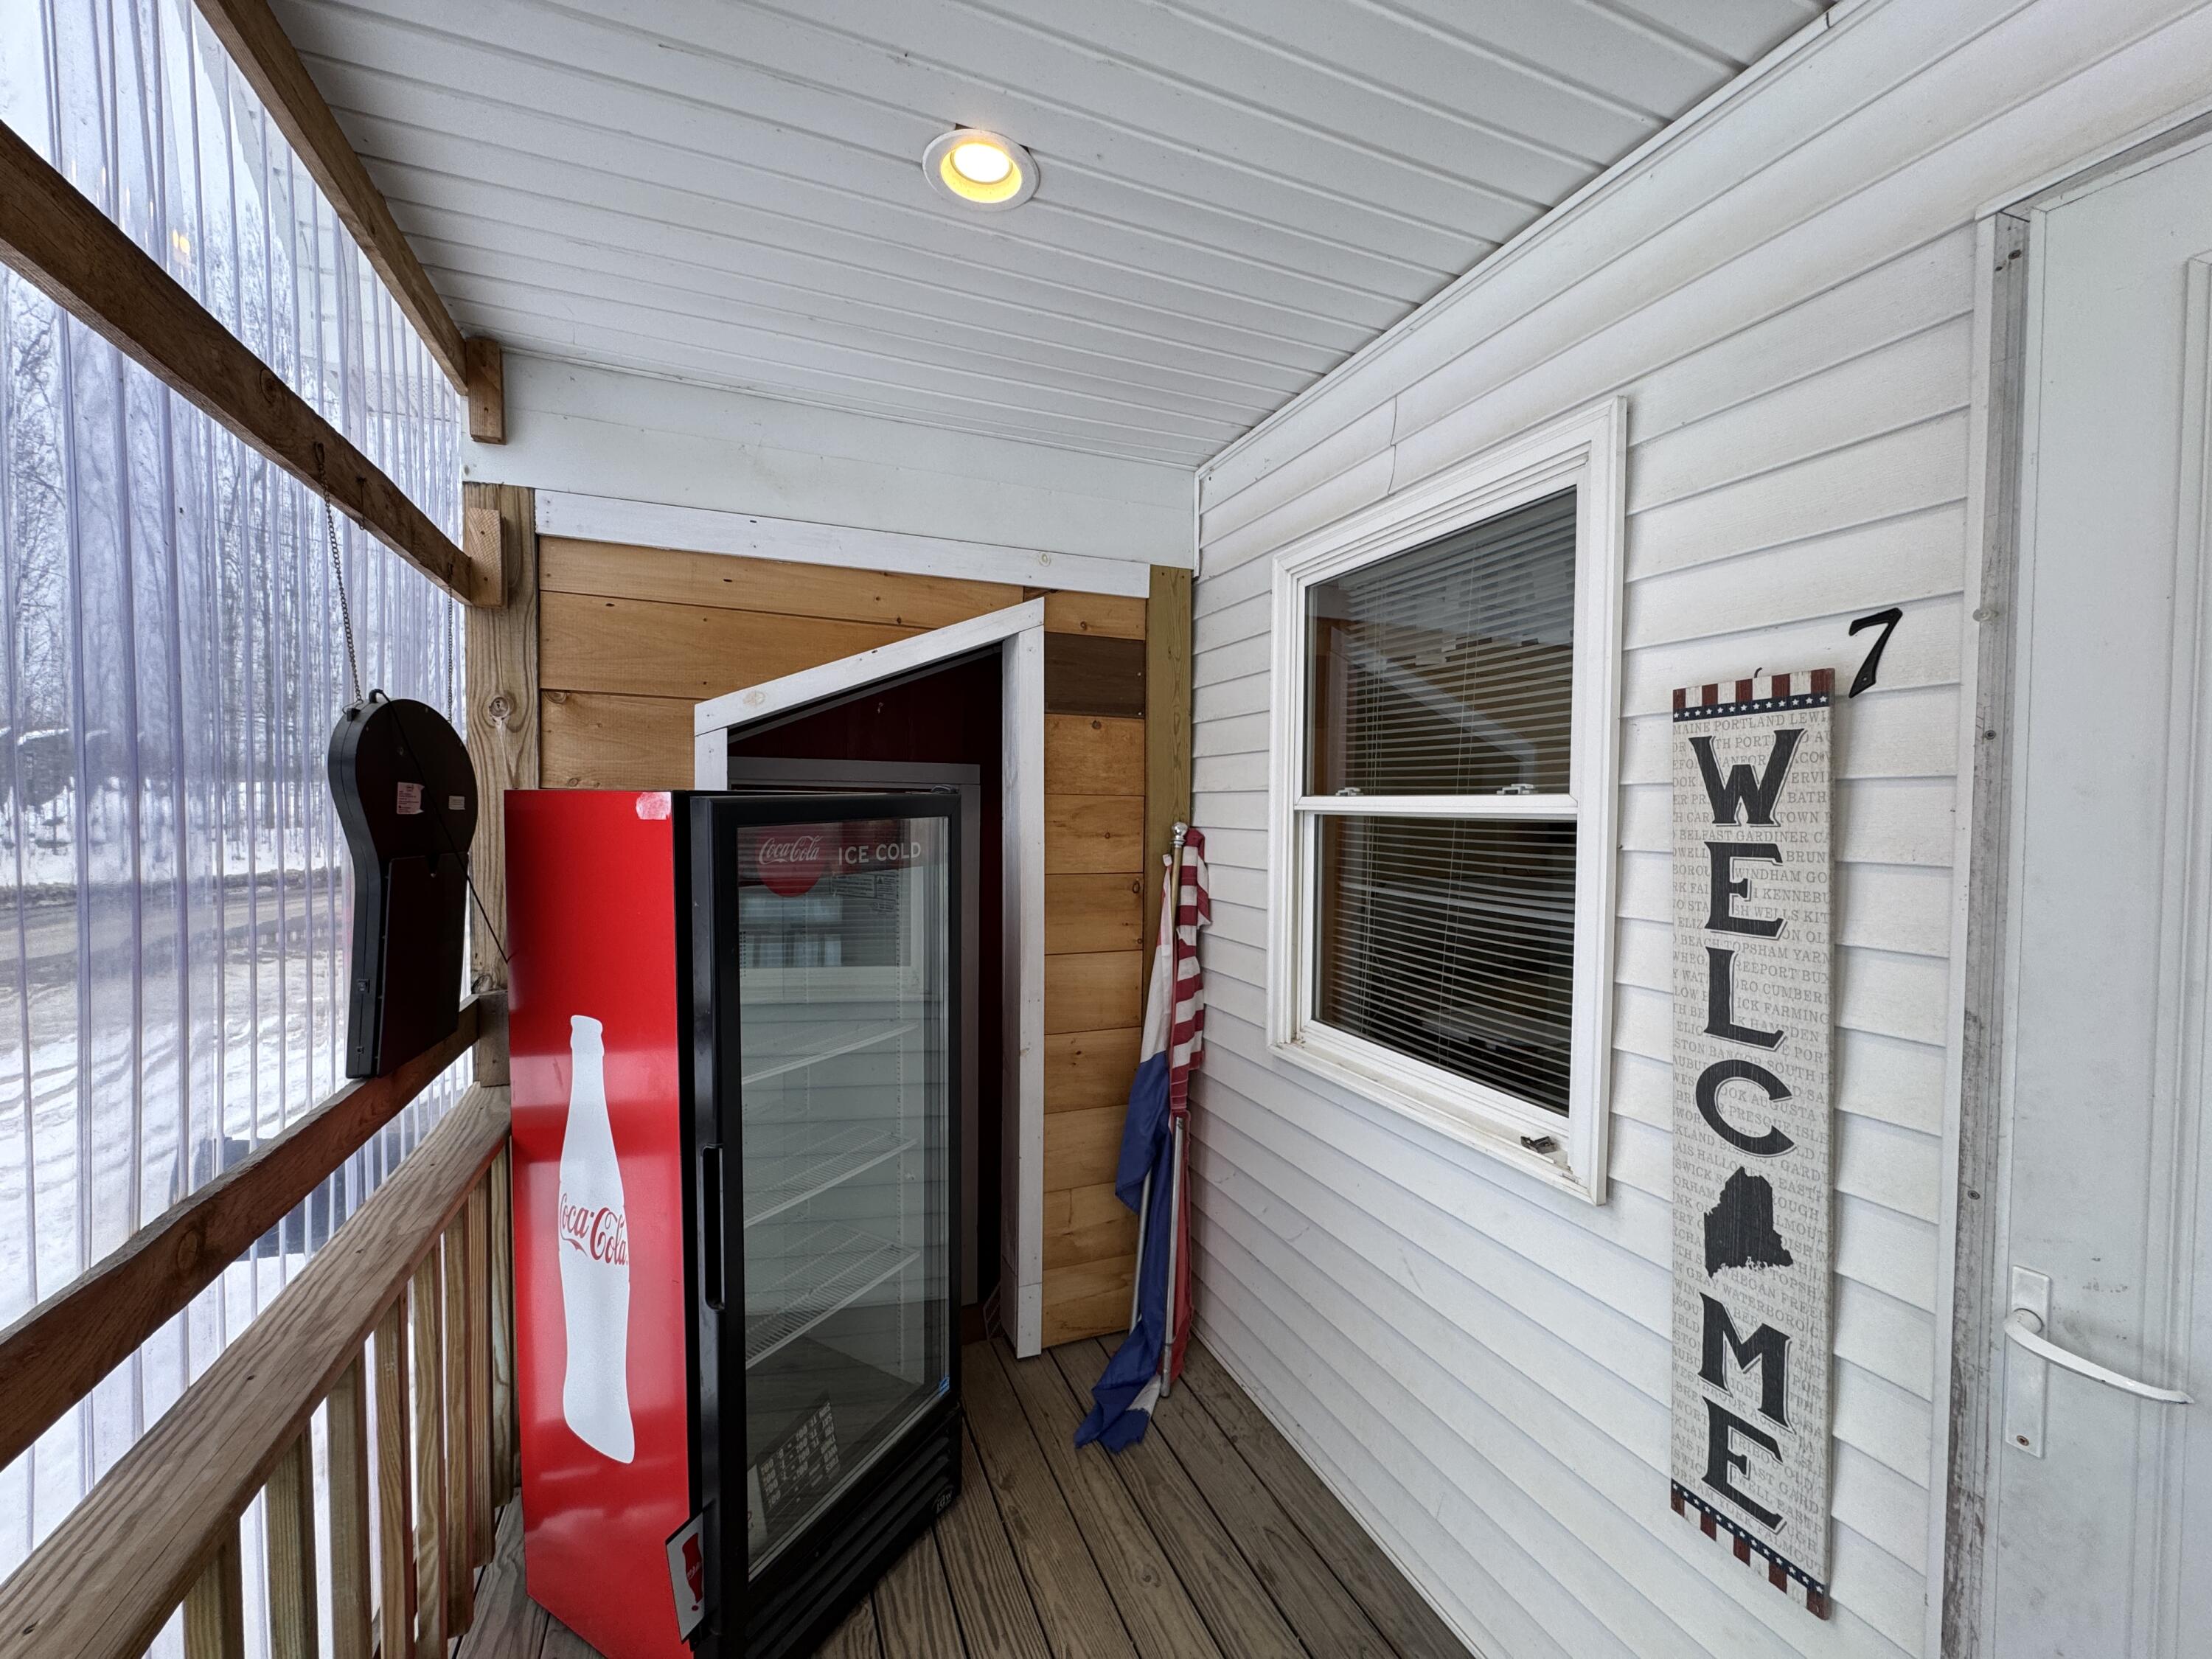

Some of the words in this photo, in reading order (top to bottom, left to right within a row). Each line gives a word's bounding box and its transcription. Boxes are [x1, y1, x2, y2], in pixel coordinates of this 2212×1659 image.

[1848, 607, 1903, 698] 7
[1714, 714, 1784, 731] PORTLAND
[1787, 792, 1825, 803] BATH
[1778, 812, 1818, 823] TOWN
[1679, 830, 1733, 841] BELFAST
[1736, 830, 1807, 843] GARDINER
[759, 835, 824, 866] Coca-Cola
[838, 846, 869, 866] ICE
[875, 841, 922, 862] COLD
[1734, 867, 1801, 882] WINDHAM
[1723, 939, 1787, 959] TOPSHAM
[1674, 1037, 1705, 1054] STON
[1767, 1059, 1815, 1082] SOUTH
[560, 1192, 628, 1266] Coca-Cola
[1686, 1265, 1719, 1291] GRAY
